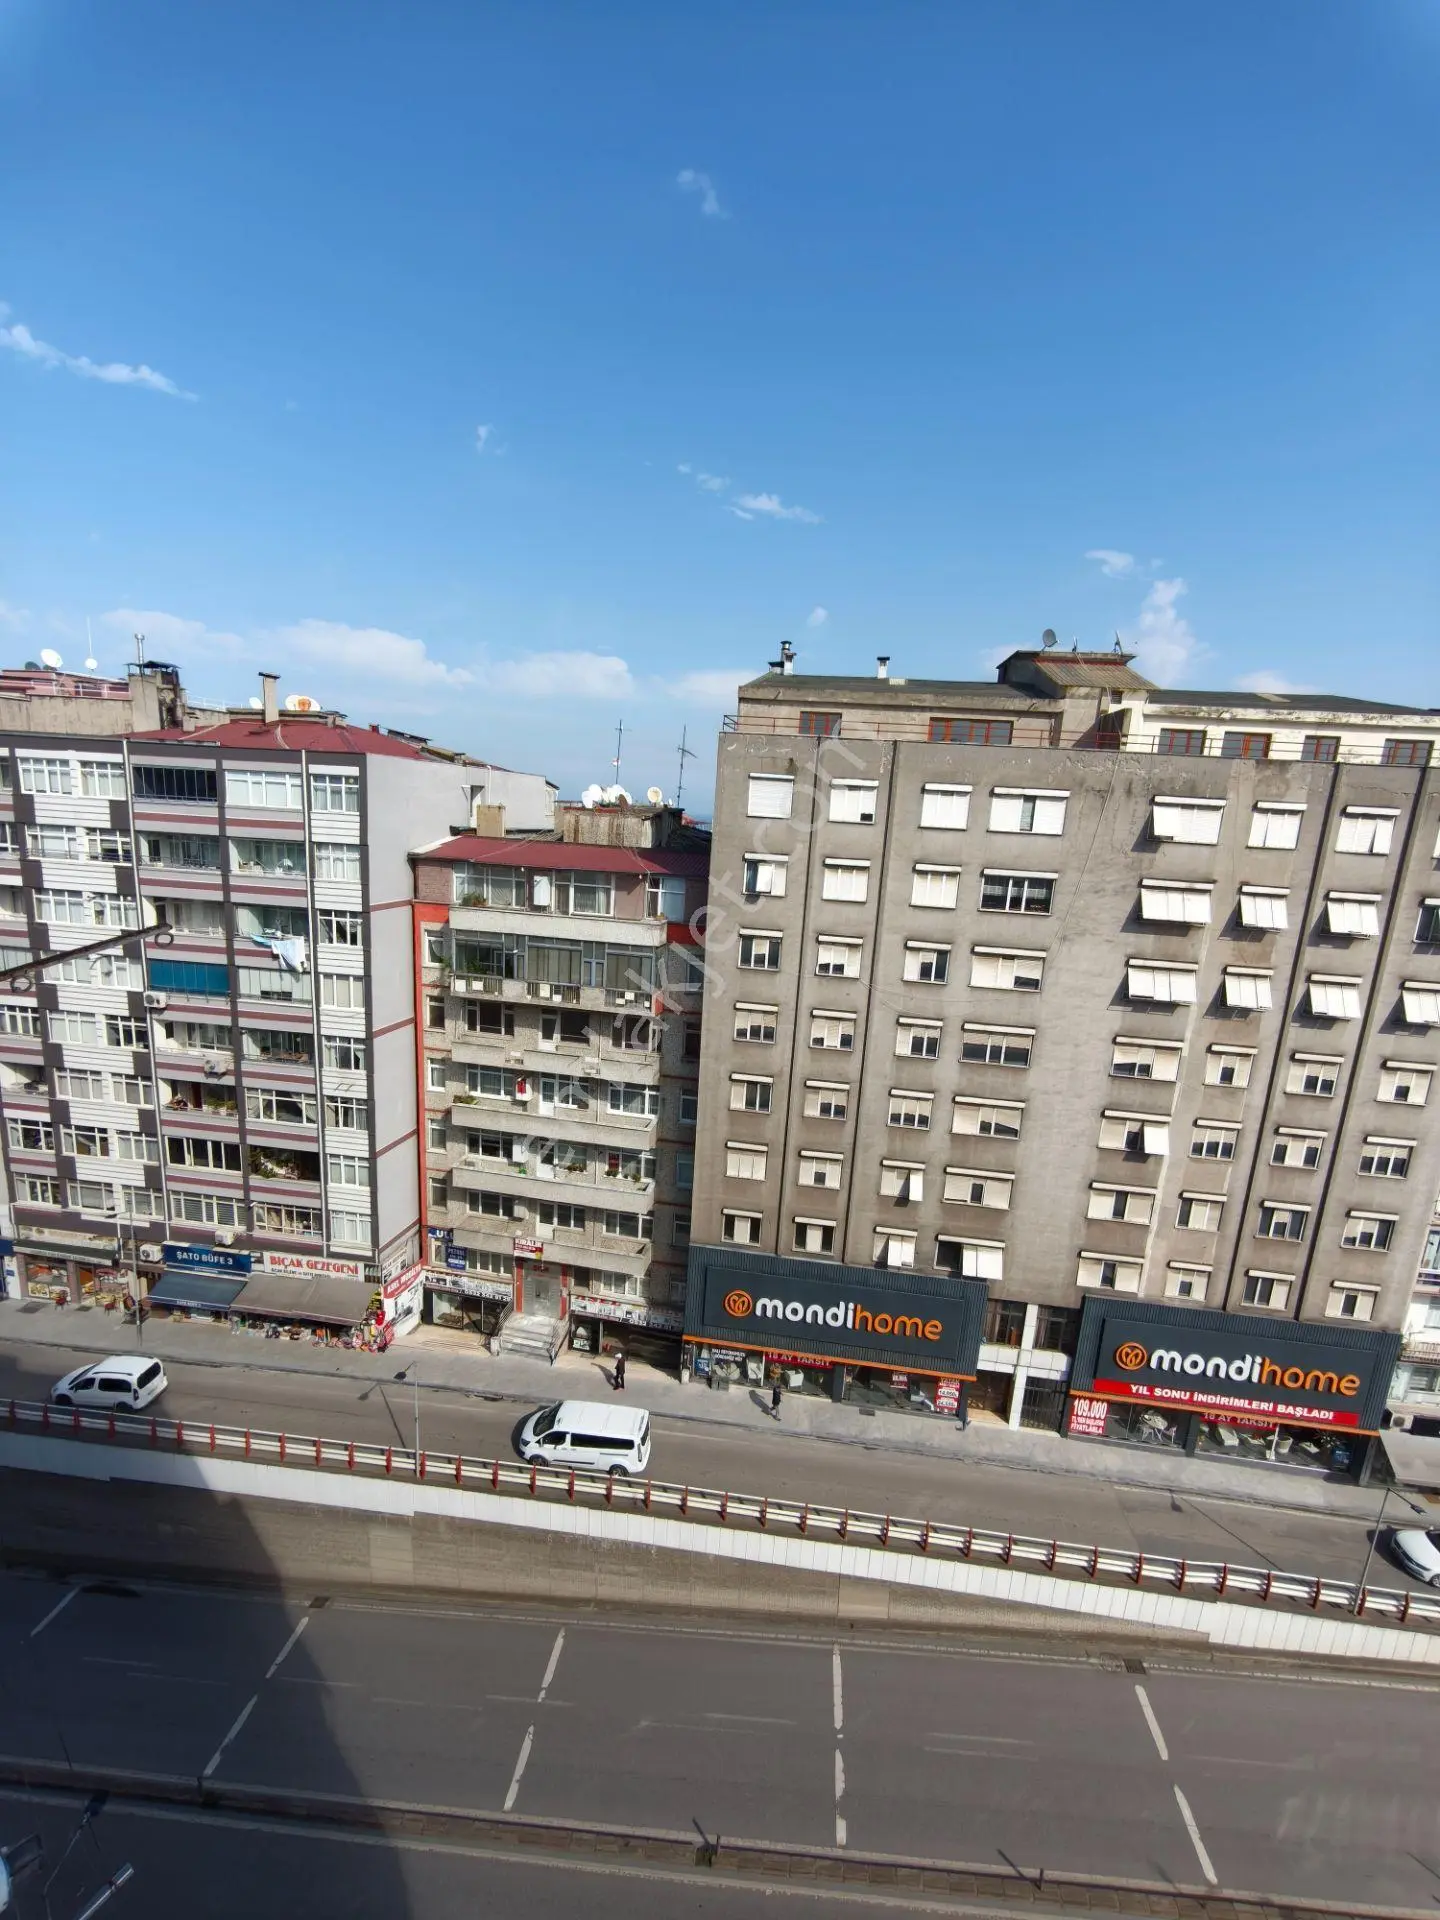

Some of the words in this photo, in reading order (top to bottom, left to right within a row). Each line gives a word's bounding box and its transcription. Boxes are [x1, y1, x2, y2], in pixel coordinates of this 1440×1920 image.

[177, 1251, 200, 1261] ŞATO
[202, 1253, 226, 1264] BÜFE
[227, 1257, 233, 1265] 3
[270, 1255, 303, 1270] BIÇAK
[306, 1260, 359, 1275] GEZEGENİ
[755, 1297, 944, 1342] mondihome
[780, 1353, 793, 1361] AY
[1150, 1348, 1361, 1396] mondihome
[1073, 1398, 1107, 1419] 109.000
[1130, 1384, 1151, 1395] YIL
[1154, 1387, 1190, 1401] SONU
[1193, 1391, 1274, 1412] İNDİRİMLERİ
[1277, 1404, 1335, 1420] BAŞLADI
[1217, 1413, 1233, 1422] AY
